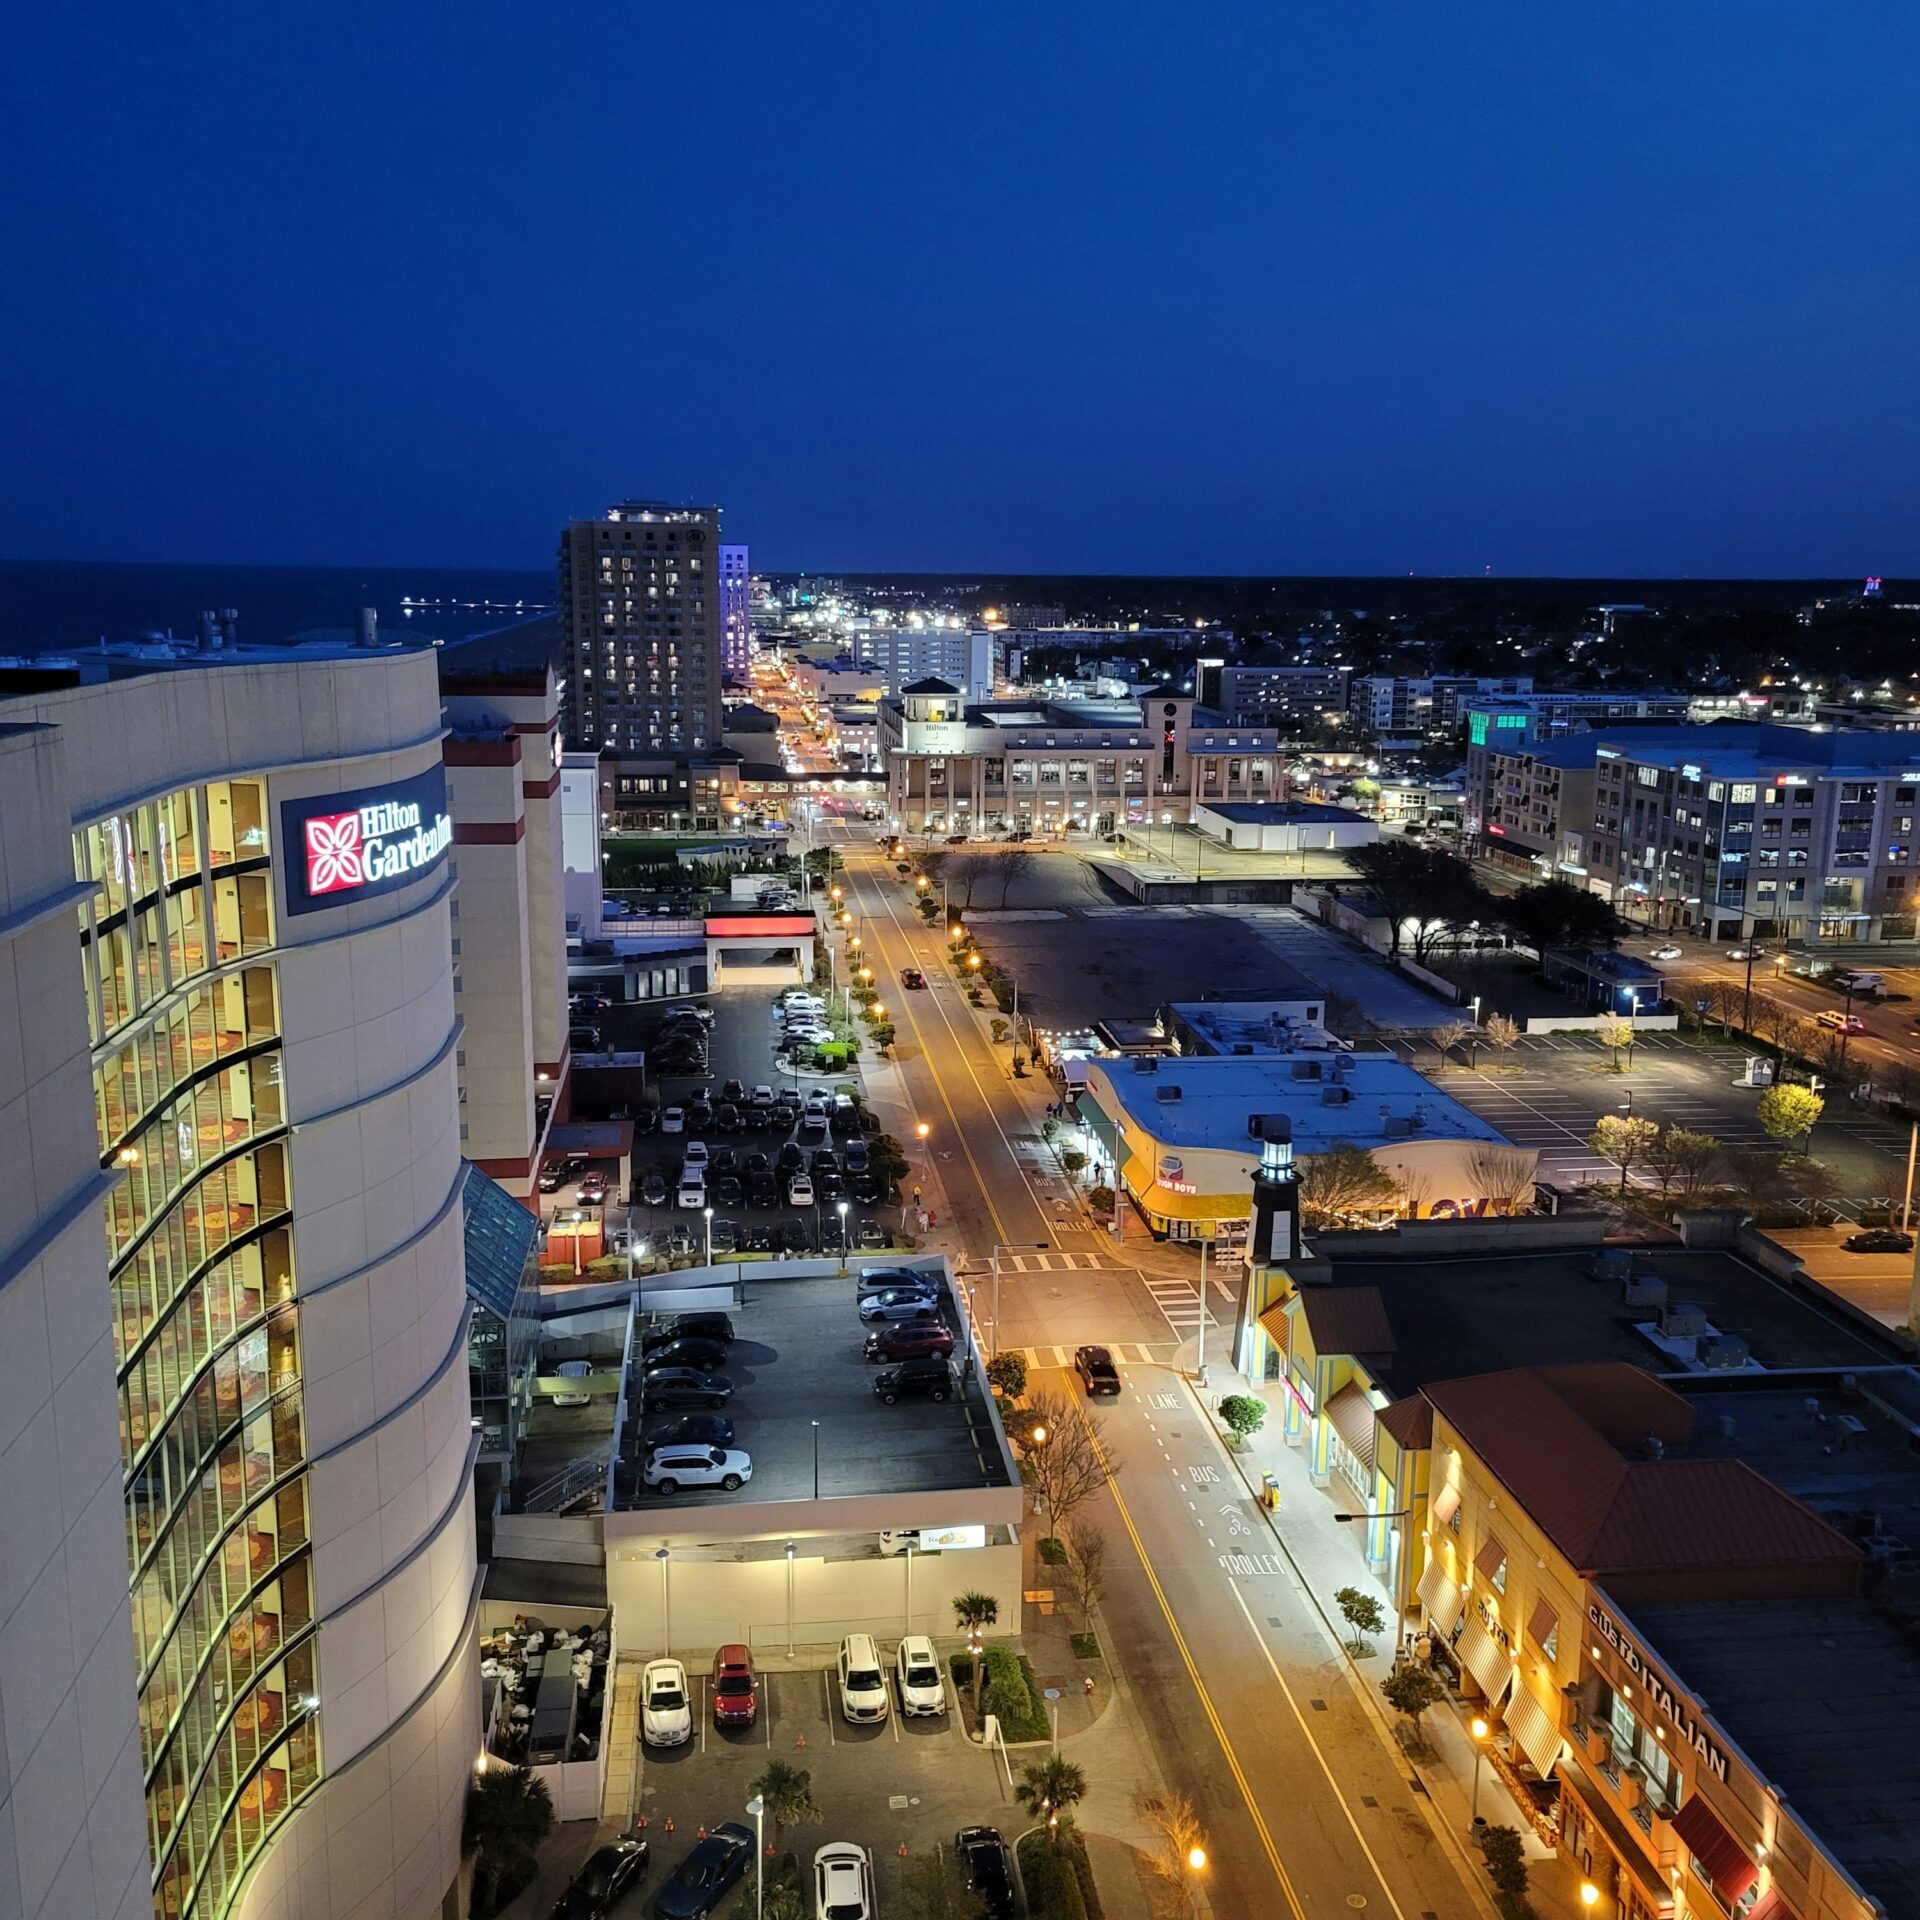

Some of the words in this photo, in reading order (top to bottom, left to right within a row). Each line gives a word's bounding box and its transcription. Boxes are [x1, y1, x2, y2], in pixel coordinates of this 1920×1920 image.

[926, 724, 949, 732] Hilton
[359, 801, 420, 839] Hilton
[362, 826, 439, 882] Garden
[1033, 1177, 1055, 1187] BUS
[1174, 1182, 1197, 1194] BOYS
[1048, 1221, 1090, 1232] TROLLEY
[1147, 1393, 1183, 1410] LANE
[1187, 1465, 1220, 1484] BUS
[1223, 1554, 1286, 1576] TROLLEY
[1588, 1604, 1640, 1674] GUSTO
[1641, 1664, 1727, 1784] ITALIAN
